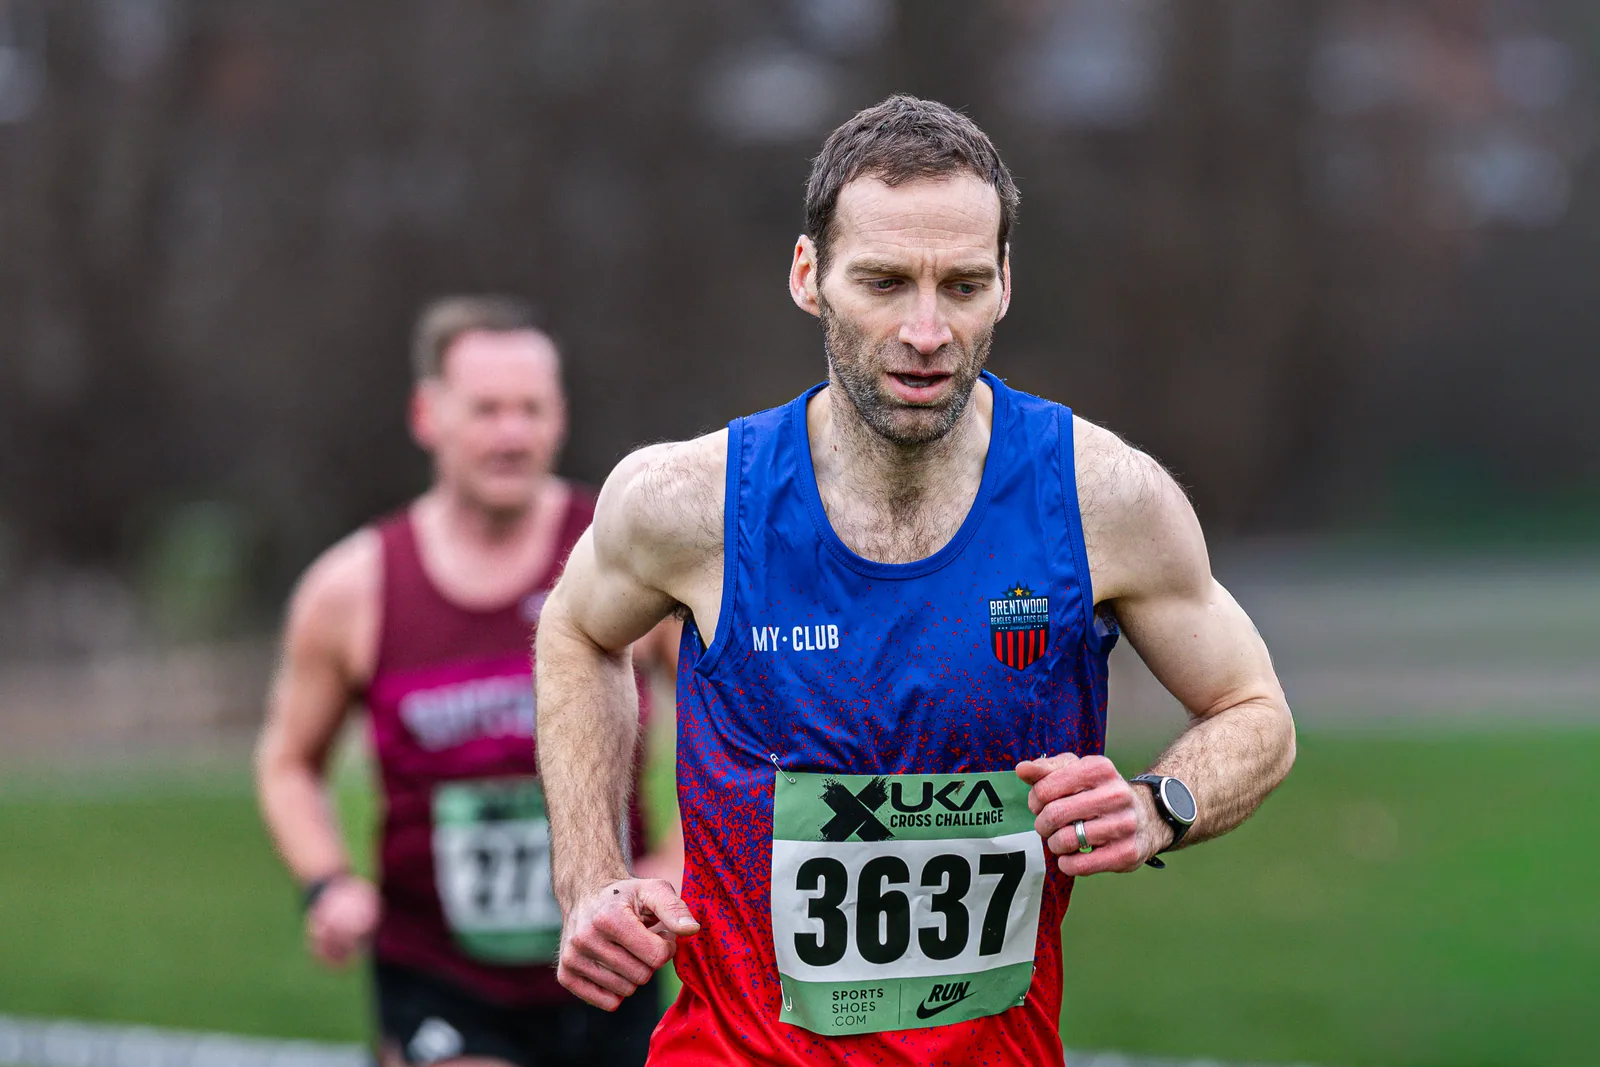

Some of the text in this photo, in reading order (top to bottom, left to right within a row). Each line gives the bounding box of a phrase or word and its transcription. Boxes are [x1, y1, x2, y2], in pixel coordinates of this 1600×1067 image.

[989, 598, 1048, 616] BRENTWOOD
[1013, 615, 1037, 624] ATHLETICS
[1037, 614, 1049, 623] CLUB
[890, 780, 1004, 813] UKA
[890, 809, 1004, 828] CROSS CHALLENGE
[794, 850, 1026, 967] 3637
[832, 988, 884, 1001] SPORTS
[928, 981, 971, 1003] RUN
[832, 1001, 876, 1014] SHOES
[831, 1015, 867, 1027] .COM
